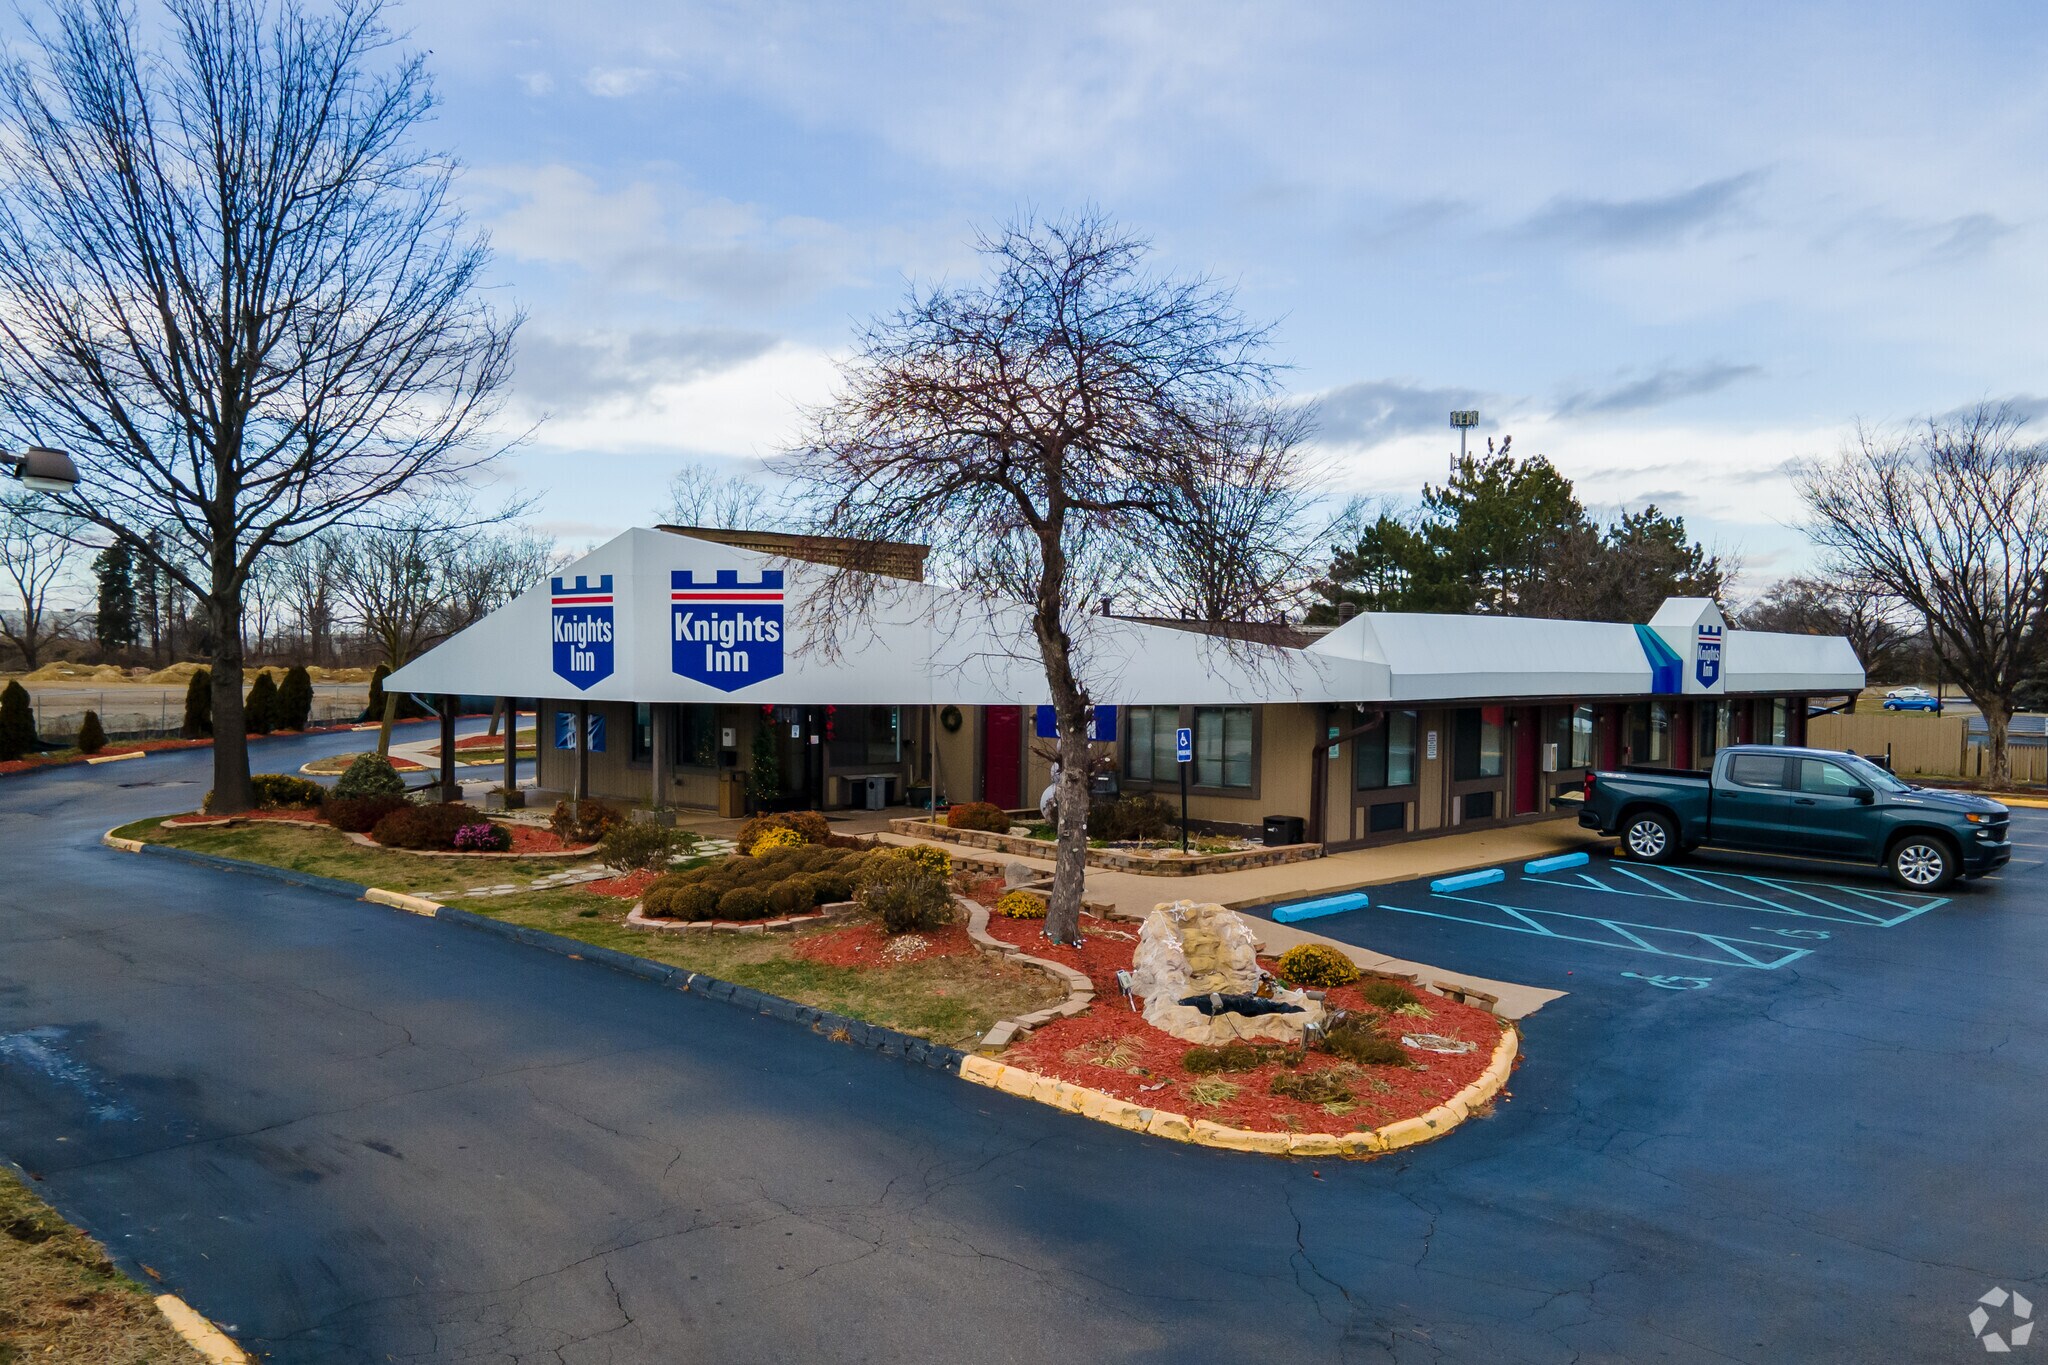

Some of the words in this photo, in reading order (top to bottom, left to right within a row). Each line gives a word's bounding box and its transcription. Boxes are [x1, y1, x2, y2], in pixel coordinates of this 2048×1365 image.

[553, 615, 612, 648] Knights
[675, 612, 780, 648] Knights
[570, 645, 595, 671] Inn
[706, 644, 749, 672] Inn
[1698, 645, 1720, 664] Knights
[1702, 661, 1713, 677] Inn
